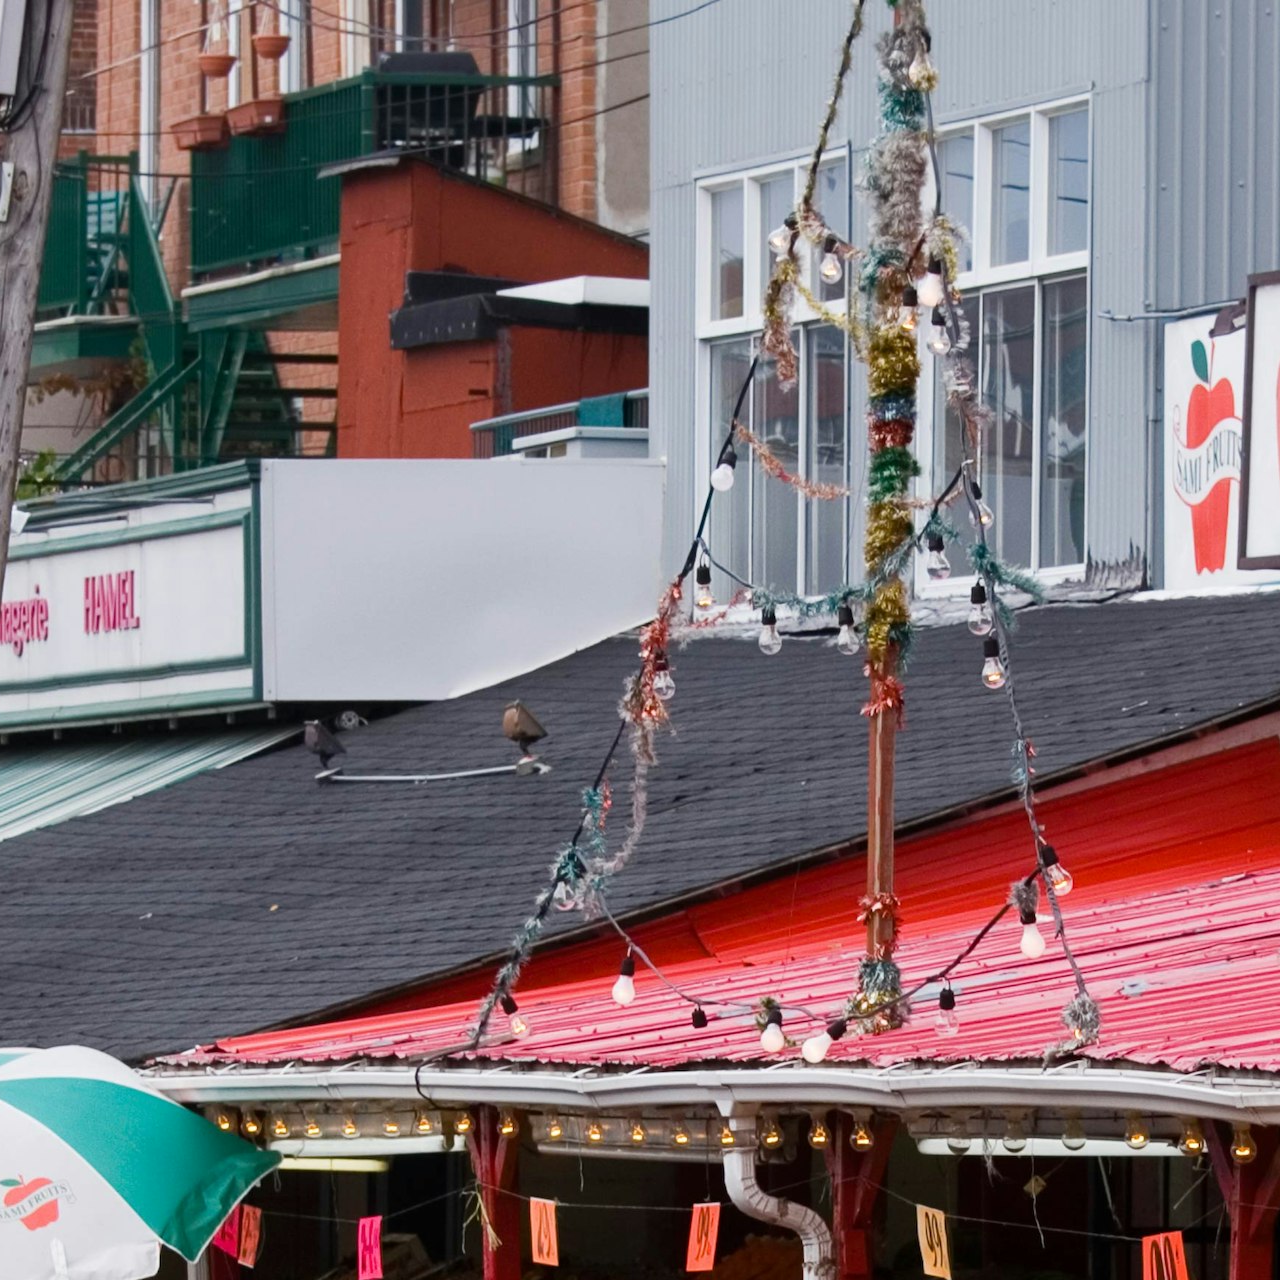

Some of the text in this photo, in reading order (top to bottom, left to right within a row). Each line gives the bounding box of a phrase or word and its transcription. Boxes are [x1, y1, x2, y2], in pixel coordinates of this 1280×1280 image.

[1176, 450, 1202, 494] SAMI
[83, 570, 140, 635] HAMEL
[27, 1184, 69, 1208] FRUITS
